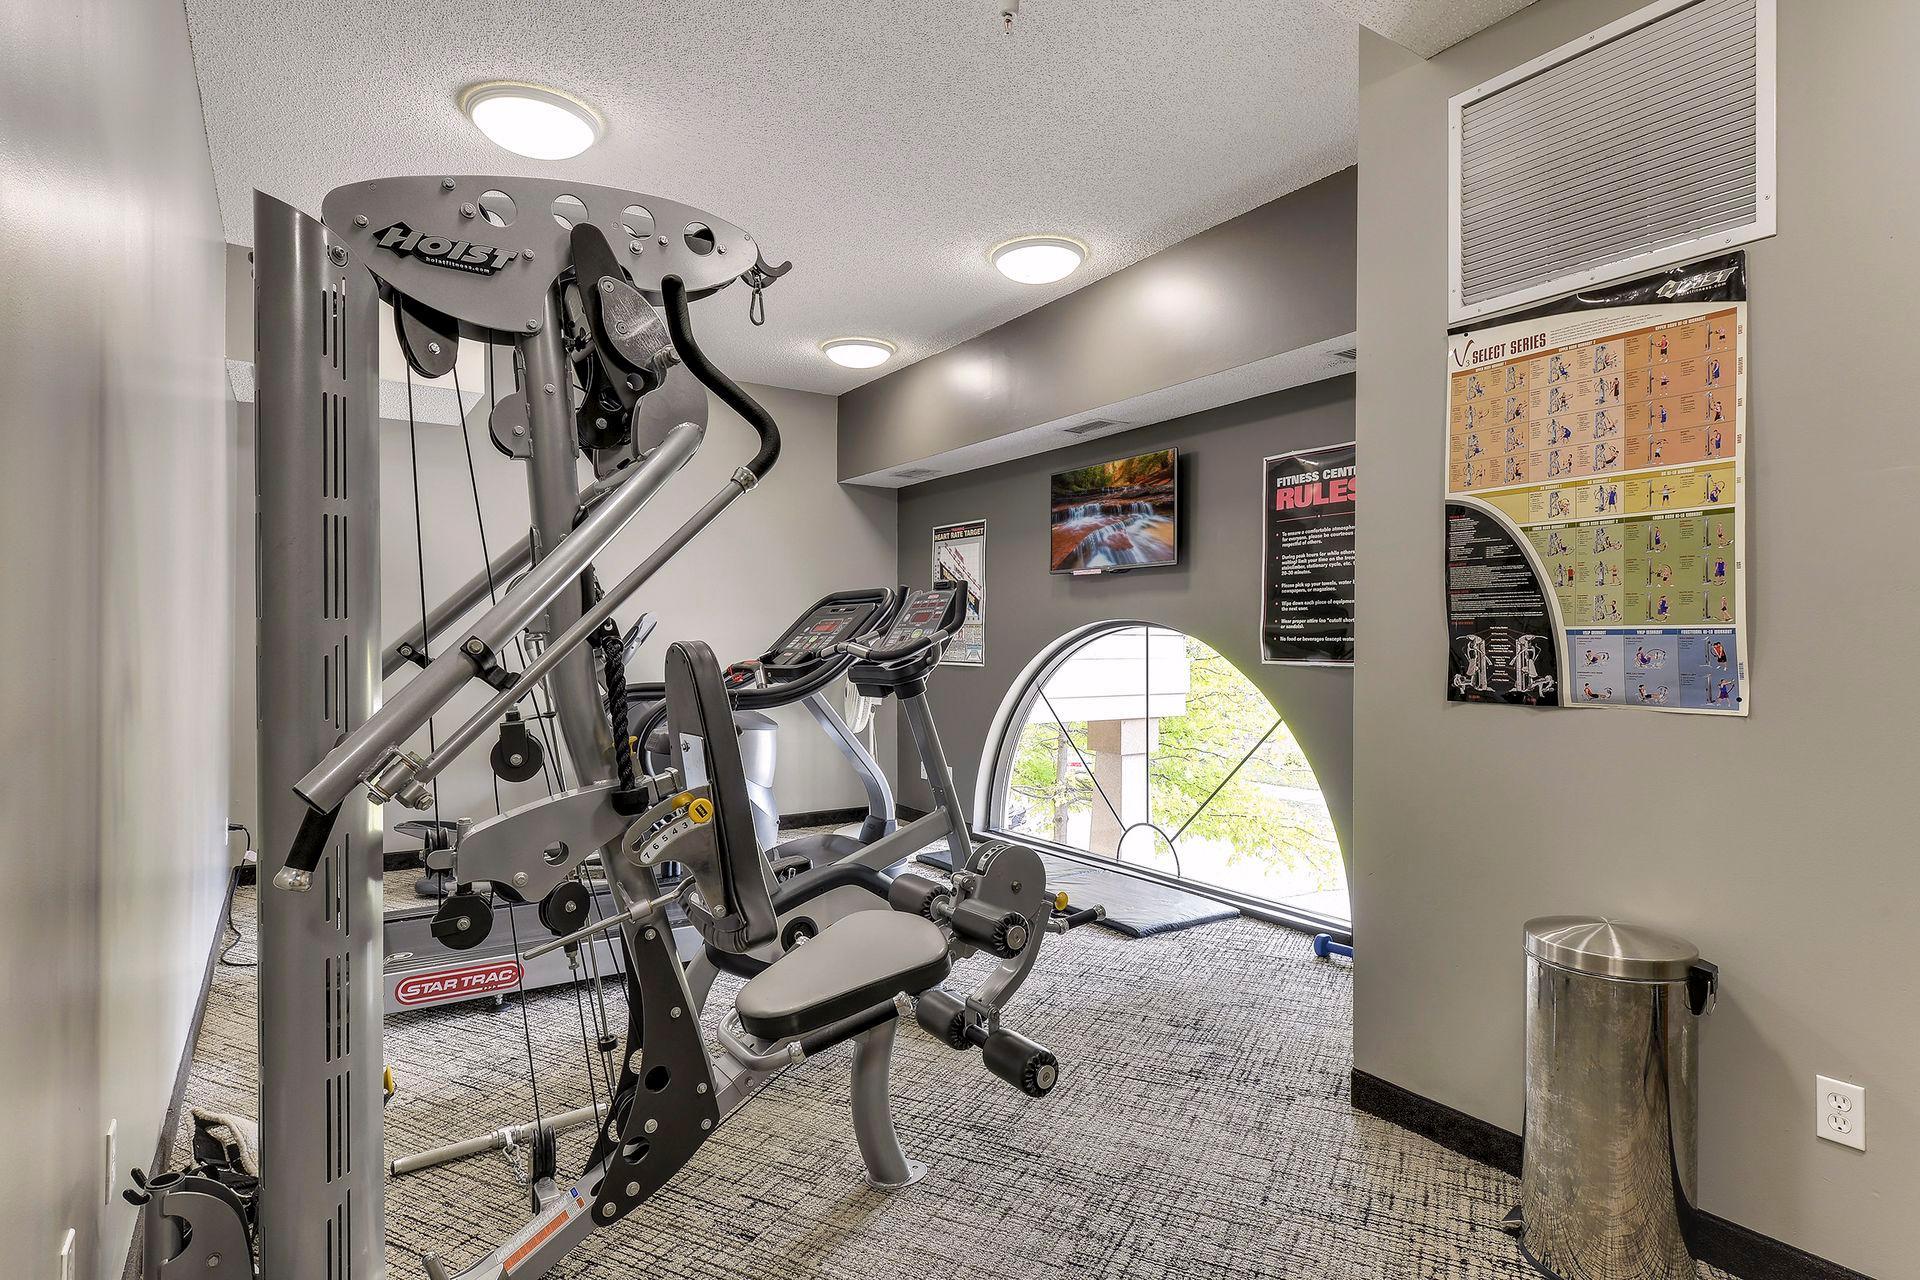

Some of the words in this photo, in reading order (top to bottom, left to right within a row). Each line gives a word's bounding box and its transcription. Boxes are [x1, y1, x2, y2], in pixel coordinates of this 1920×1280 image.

[379, 226, 519, 269] HOIST
[1472, 343, 1506, 364] SELECT
[1510, 333, 1546, 355] SERIES
[1276, 471, 1320, 488] FITNESS
[1322, 466, 1356, 480] CENT
[950, 530, 964, 539] RATE
[964, 528, 984, 536] TARGET
[407, 978, 458, 996] STAR
[460, 970, 512, 987] TRAC
